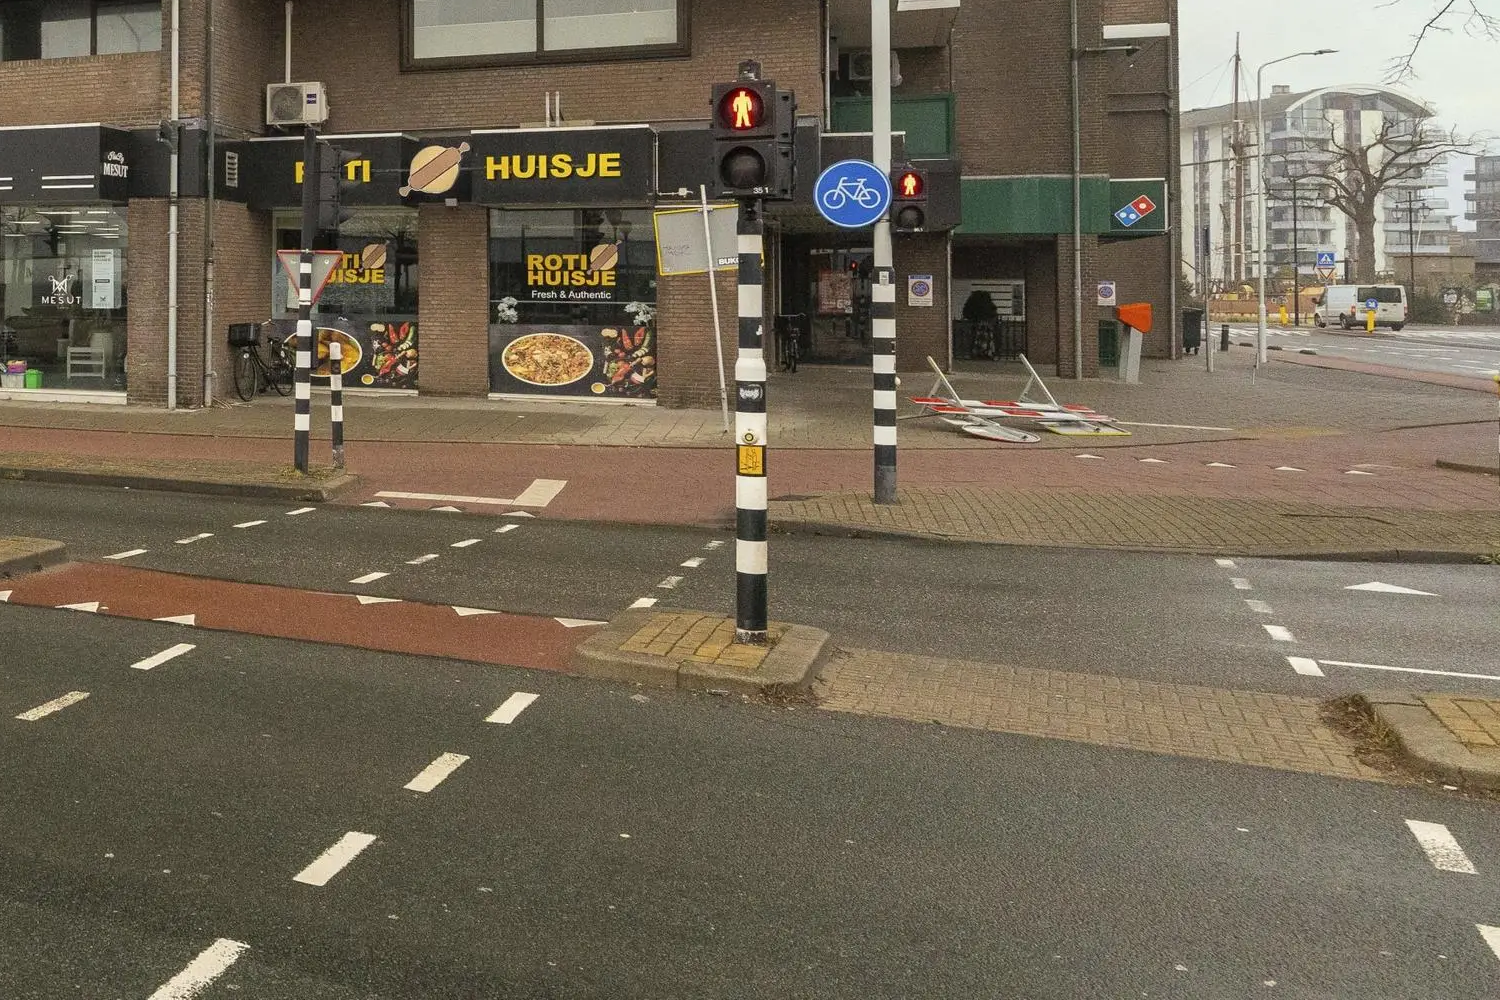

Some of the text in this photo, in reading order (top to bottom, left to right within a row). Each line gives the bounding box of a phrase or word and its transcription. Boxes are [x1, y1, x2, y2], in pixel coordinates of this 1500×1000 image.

[103, 162, 128, 178] MESUT
[486, 153, 621, 180] HUISJE
[527, 254, 588, 271] ROTI
[527, 270, 617, 286] HUISJE
[41, 296, 81, 305] MESUT
[531, 290, 612, 299] Fresh & Authentic
